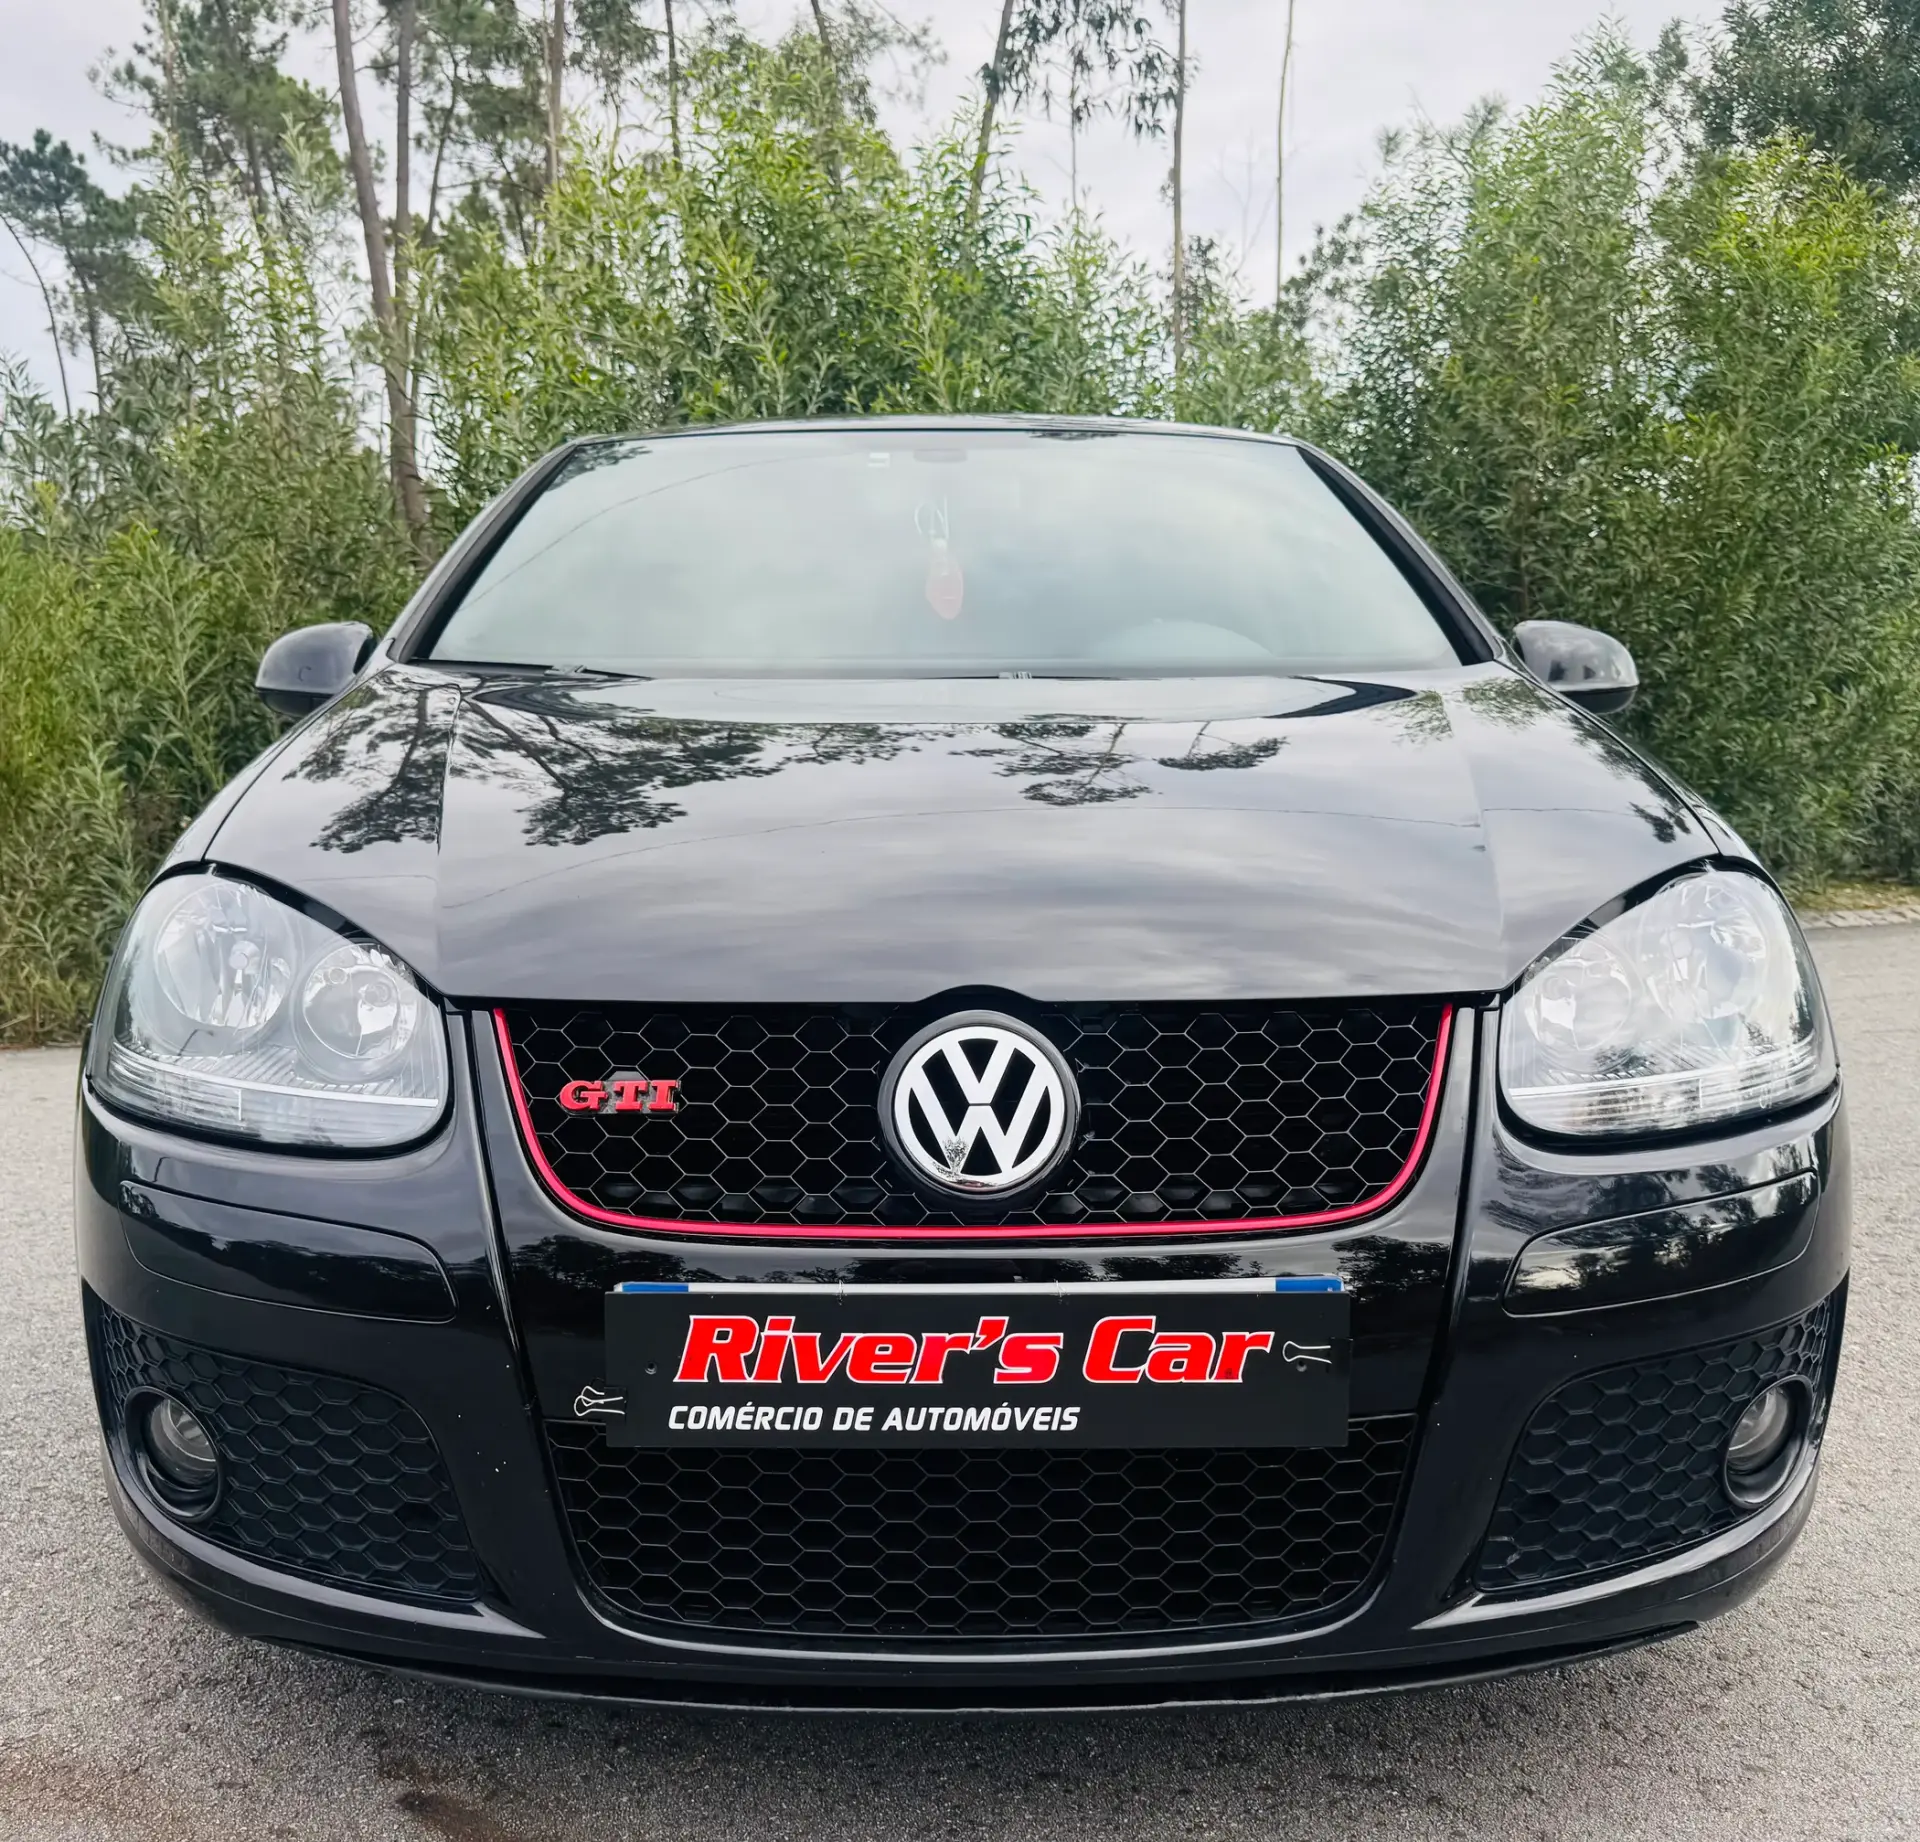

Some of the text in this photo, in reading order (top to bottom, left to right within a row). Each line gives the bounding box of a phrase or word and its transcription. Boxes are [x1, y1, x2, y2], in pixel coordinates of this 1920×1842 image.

[559, 1079, 679, 1112] GTI
[673, 1314, 1275, 1384] River's Car
[668, 1401, 1081, 1432] COMÉRCIO DE AUTOMÓVEIS
